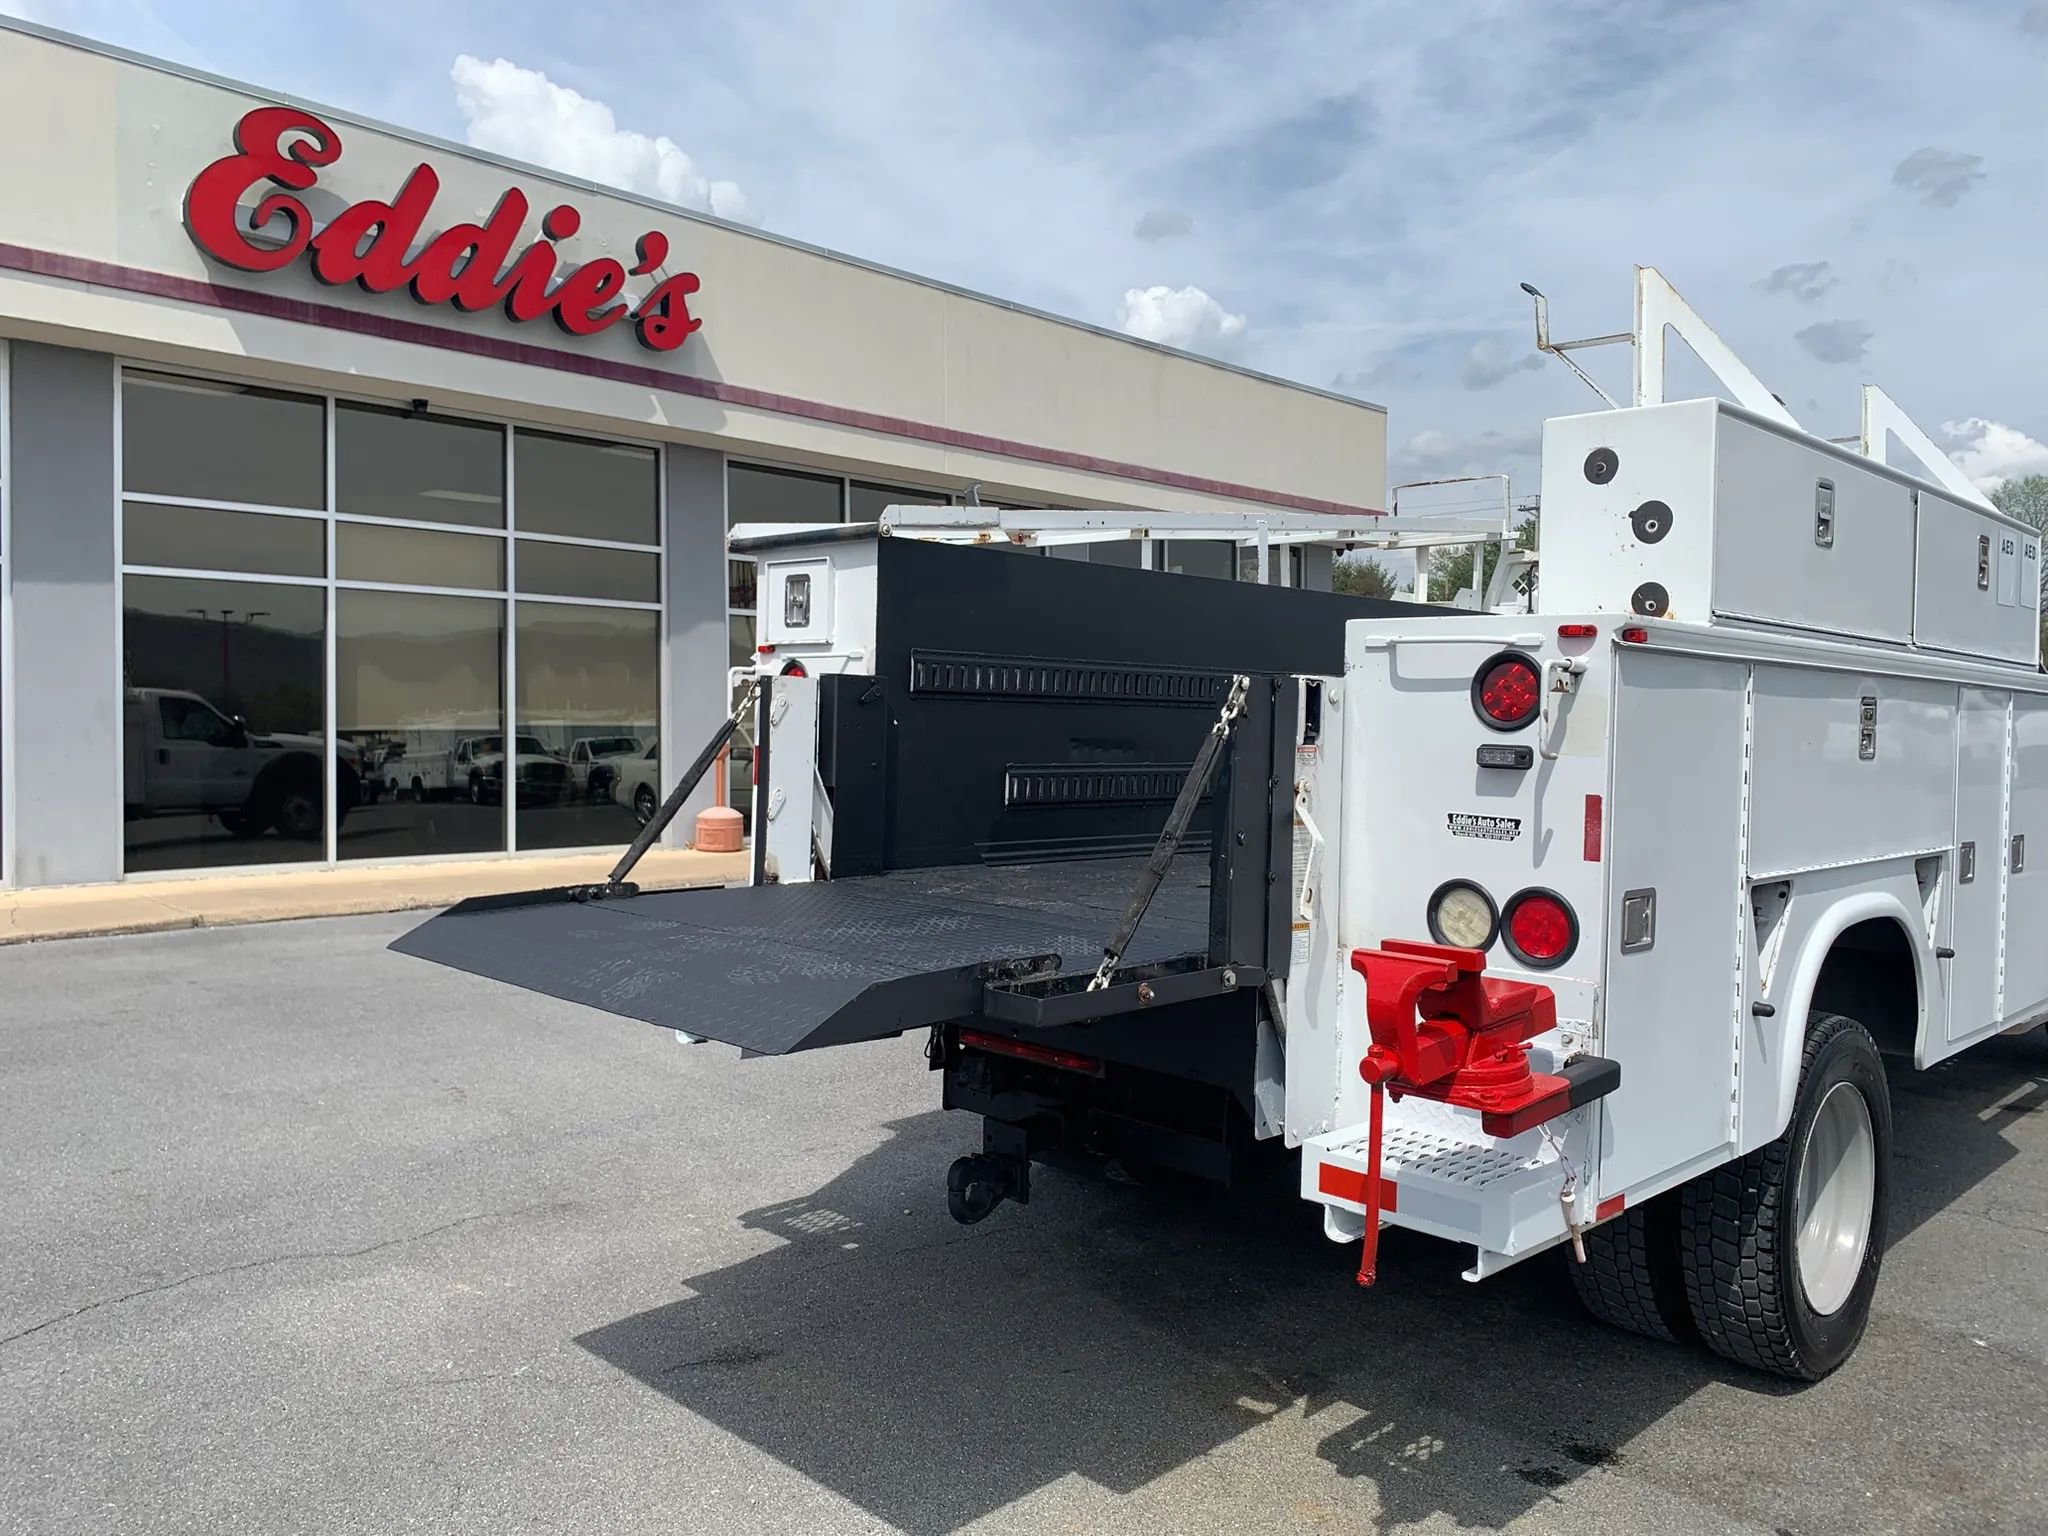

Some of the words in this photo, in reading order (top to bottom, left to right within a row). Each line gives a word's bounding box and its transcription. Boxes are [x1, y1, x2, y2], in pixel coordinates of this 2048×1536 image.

[183, 106, 703, 352] Eddie's
[1453, 815, 1477, 825] Eddie's
[1477, 816, 1495, 827] Auto
[1496, 818, 1515, 829] Sales
